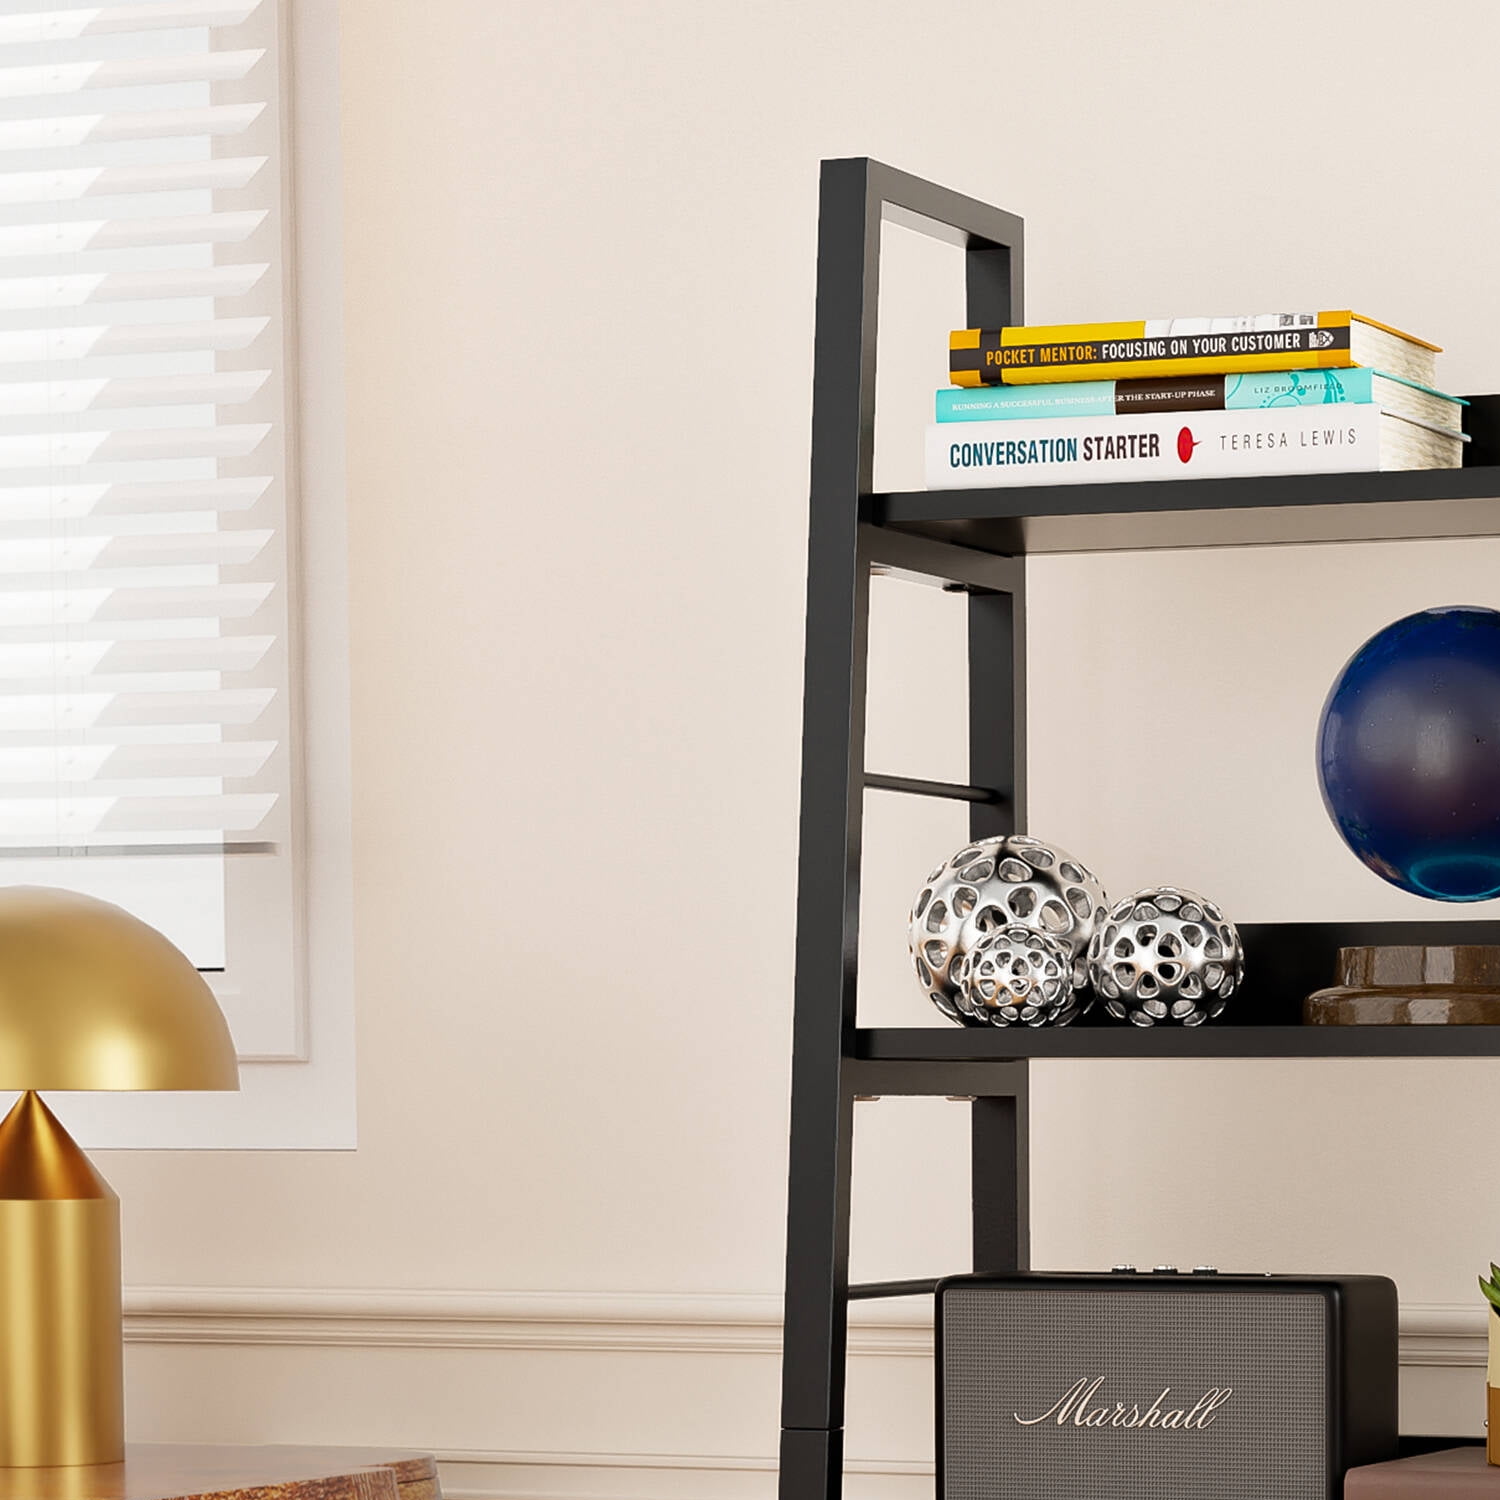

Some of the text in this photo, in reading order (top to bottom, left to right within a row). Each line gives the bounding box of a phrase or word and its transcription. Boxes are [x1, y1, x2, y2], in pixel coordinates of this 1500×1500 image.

[986, 332, 1301, 366] POCKET MENTOR: FOCUSING ON YOUR CUSTOMER
[1125, 393, 1144, 402] THE
[1145, 390, 1187, 400] START-UP
[1188, 389, 1216, 398] PHASE
[1254, 386, 1270, 394] LIZ
[950, 428, 1357, 468] CONVERSATION STARTER TERESA LEWIS
[1014, 1376, 1233, 1429] Marshall
